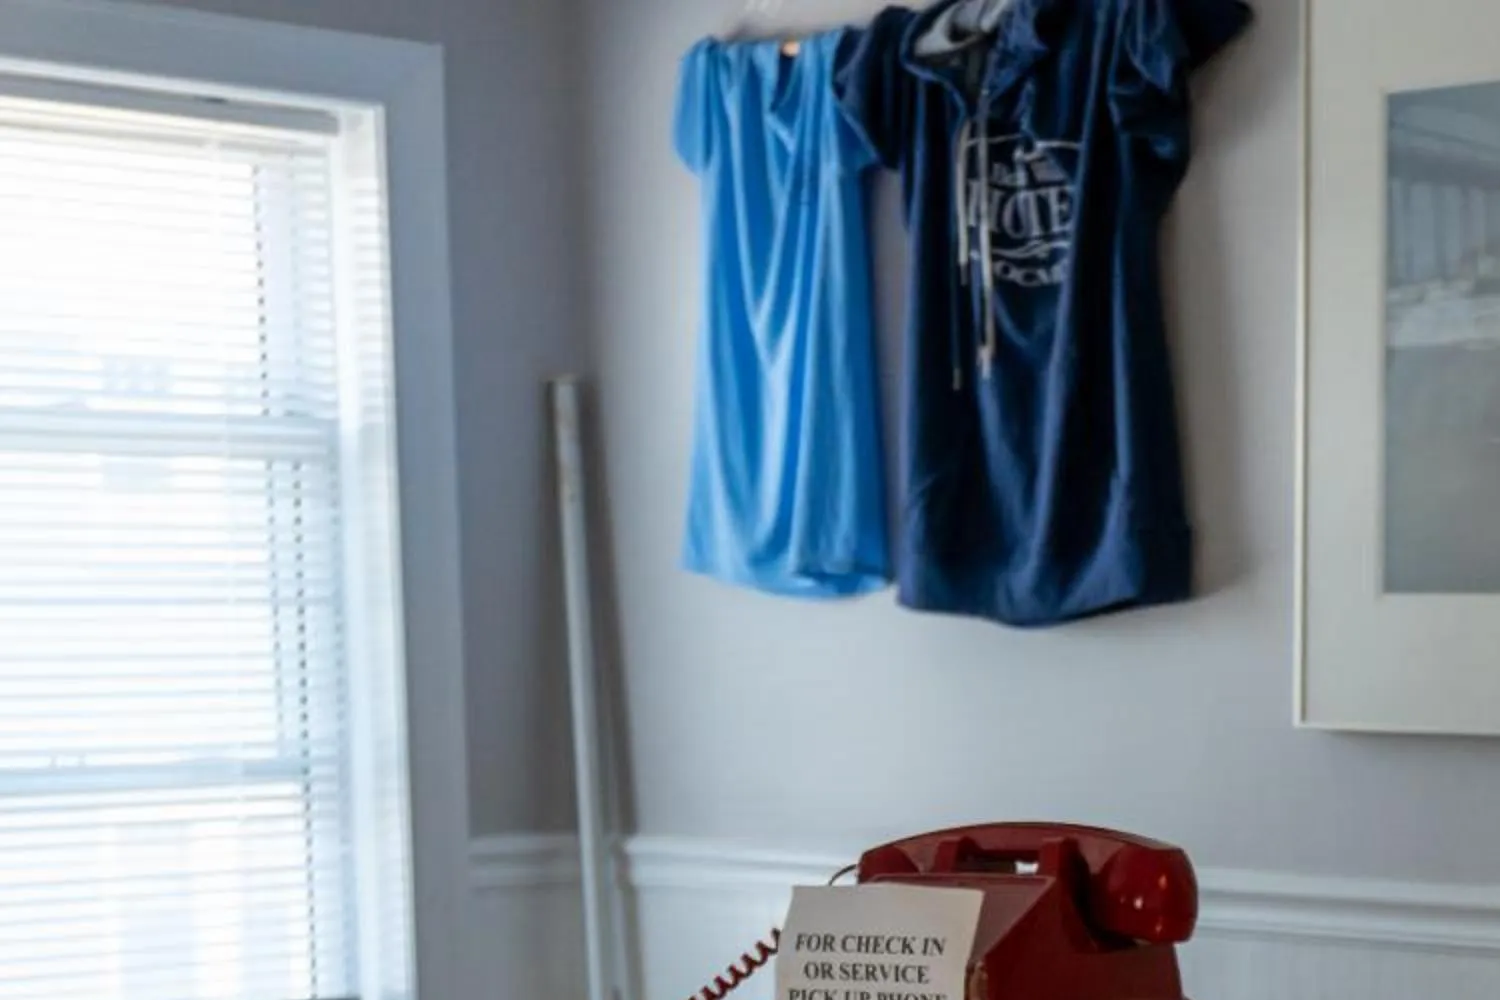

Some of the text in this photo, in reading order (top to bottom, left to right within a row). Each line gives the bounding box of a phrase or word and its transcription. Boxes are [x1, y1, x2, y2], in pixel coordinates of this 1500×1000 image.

[795, 933, 946, 956] FOR CHECK IN
[804, 962, 930, 984] OR SERVICE
